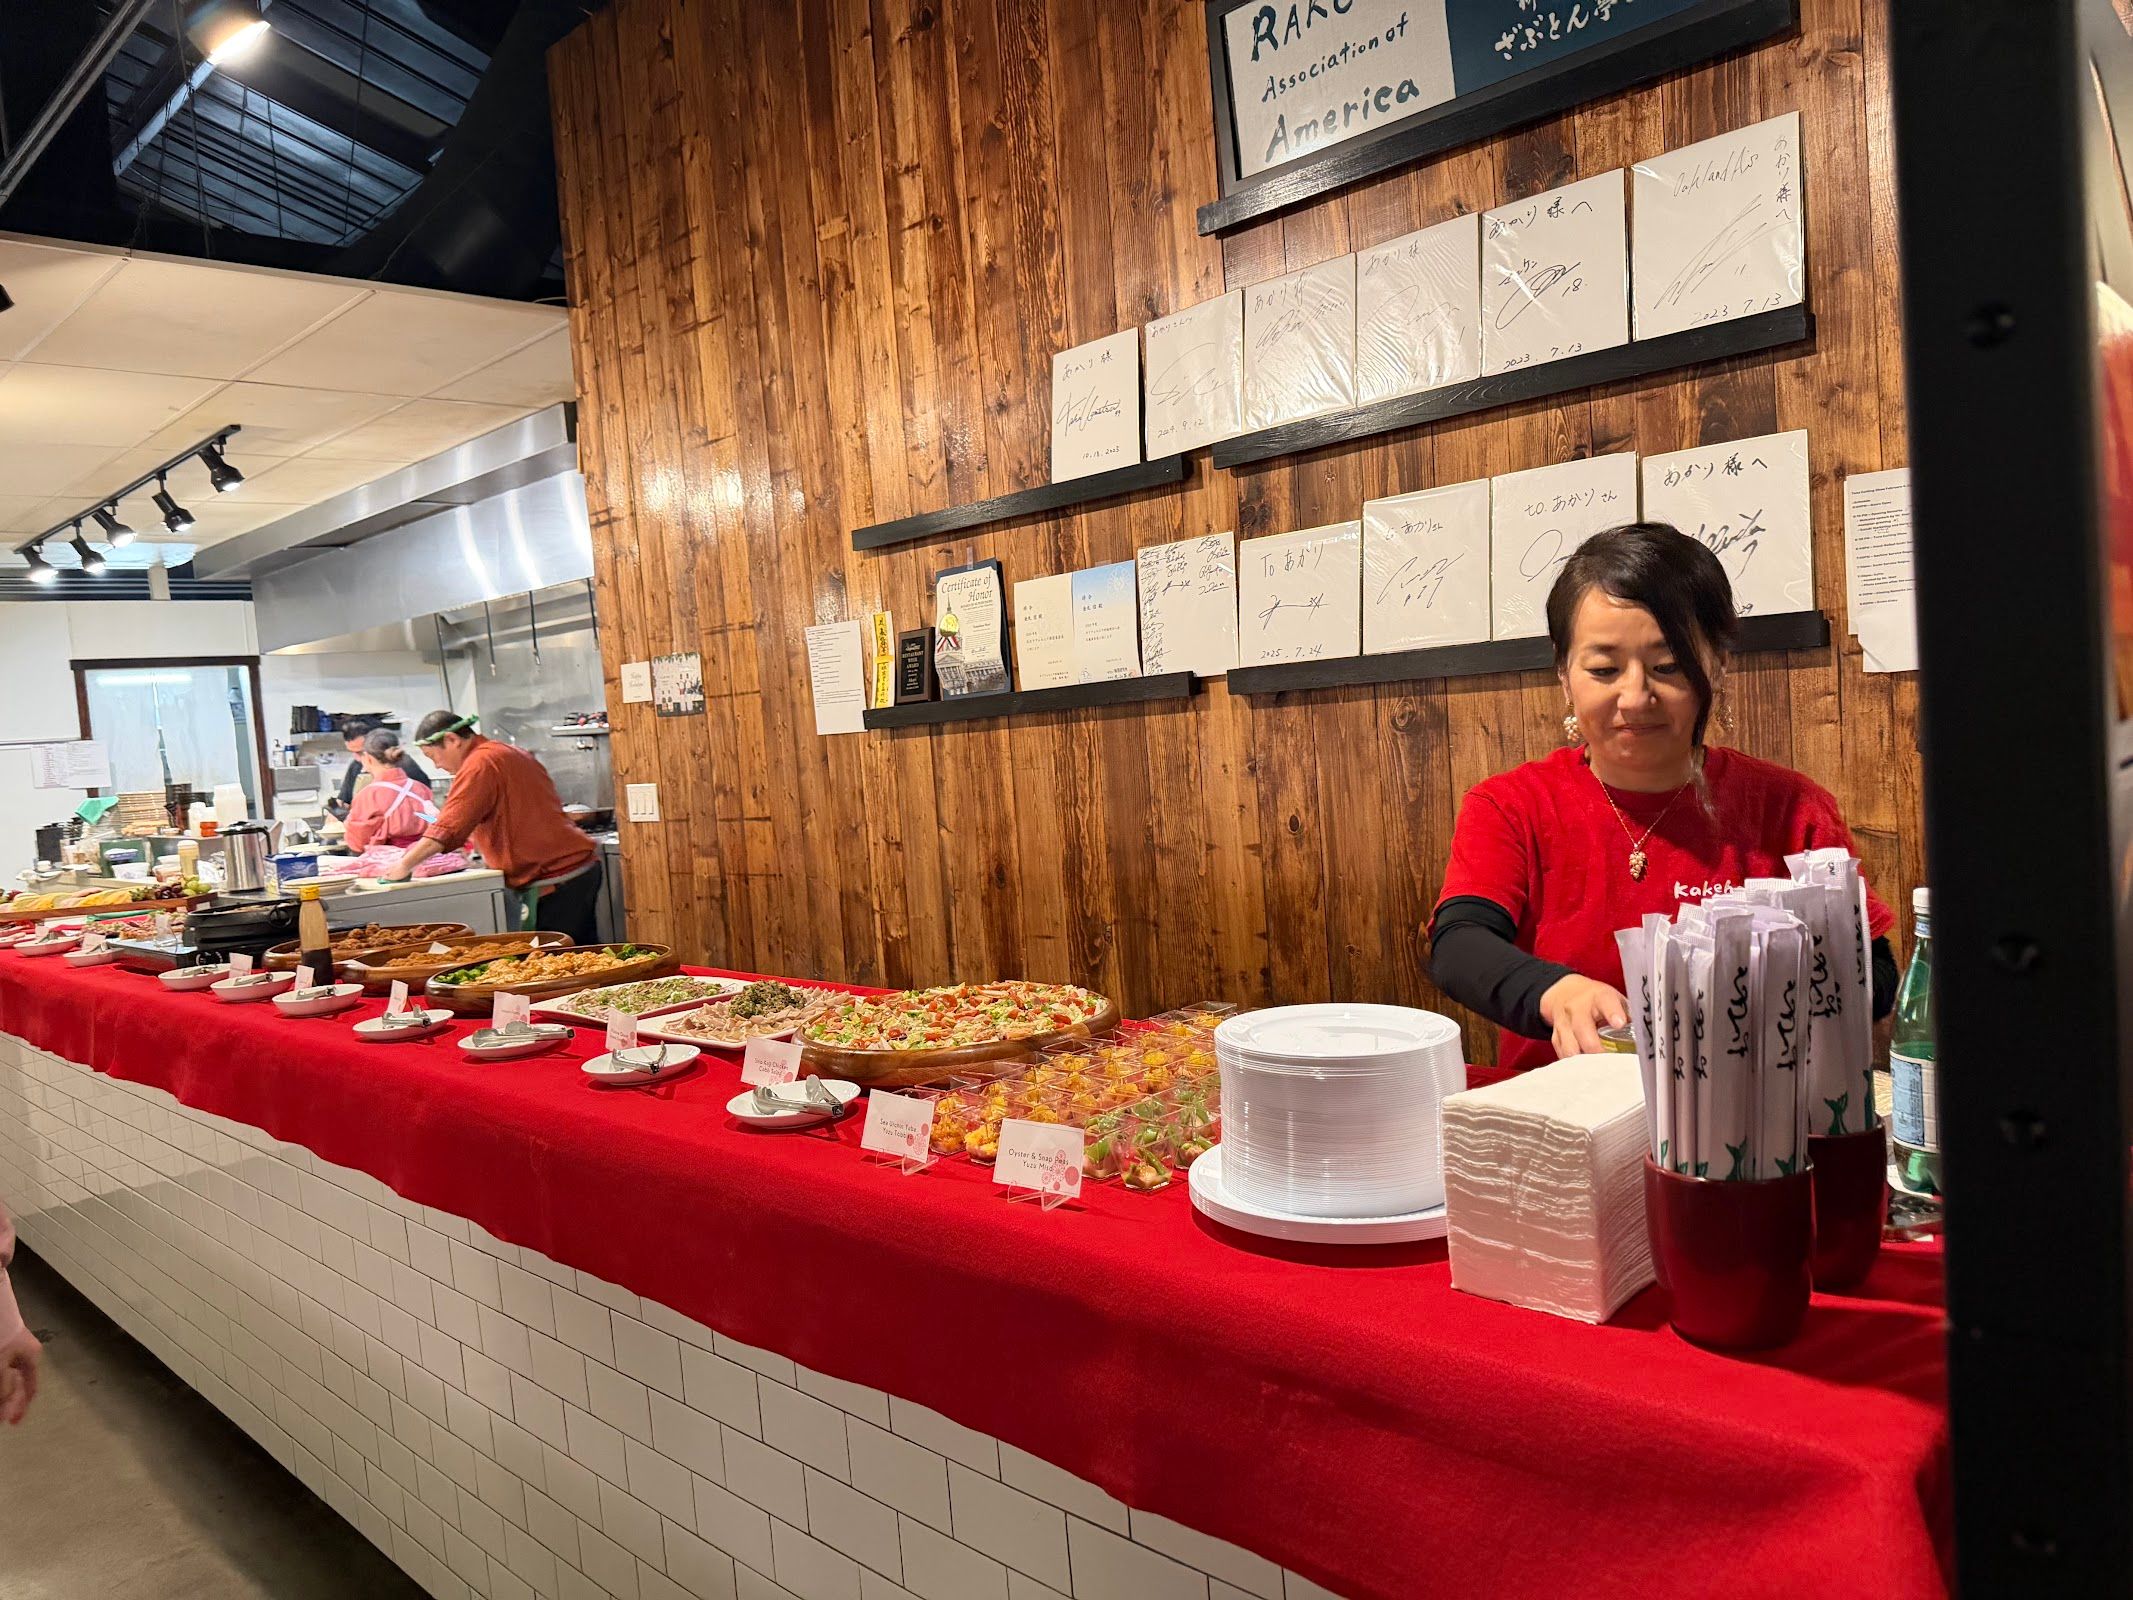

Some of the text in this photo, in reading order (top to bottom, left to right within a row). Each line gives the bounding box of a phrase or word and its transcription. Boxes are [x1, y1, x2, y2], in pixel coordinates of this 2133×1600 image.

[1261, 12, 1409, 103] Association of
[1265, 78, 1420, 163] America
[1673, 150, 1728, 197] Oakland
[1260, 553, 1275, 578] To
[941, 571, 992, 595] Certificate of
[967, 589, 992, 604] Honor
[1674, 879, 1745, 900] Kakeh
[880, 1118, 888, 1126] Sea
[1008, 1148, 1069, 1166] Oyster & Snap Peas
[1023, 1160, 1037, 1169] Yuzu
